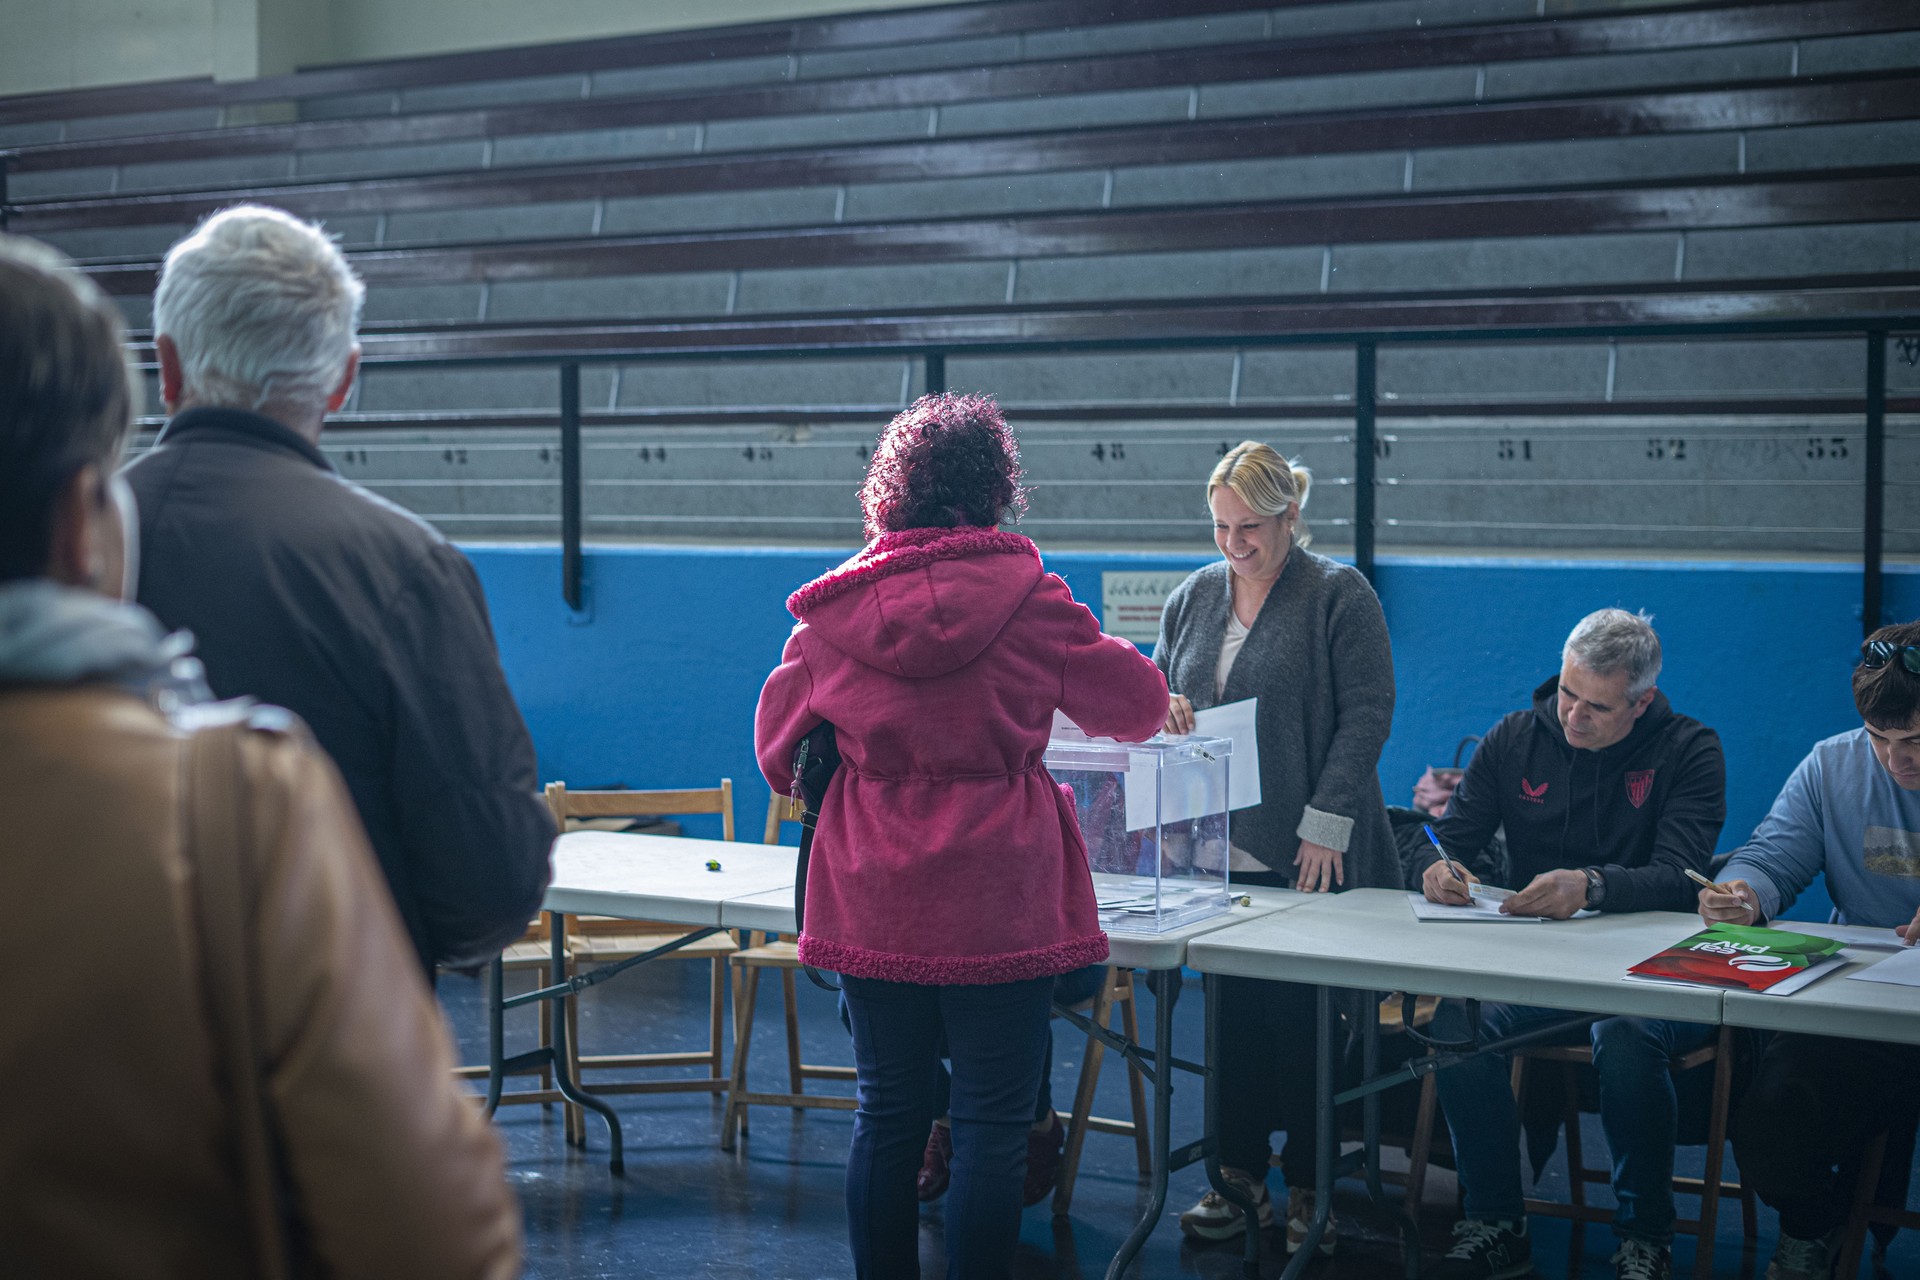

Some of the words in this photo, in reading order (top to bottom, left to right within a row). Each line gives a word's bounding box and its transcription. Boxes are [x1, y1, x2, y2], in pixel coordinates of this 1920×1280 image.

[1091, 443, 1125, 461] 48
[1498, 438, 1532, 461] 51
[1647, 438, 1686, 460] 52
[1712, 940, 1771, 955] pnv
